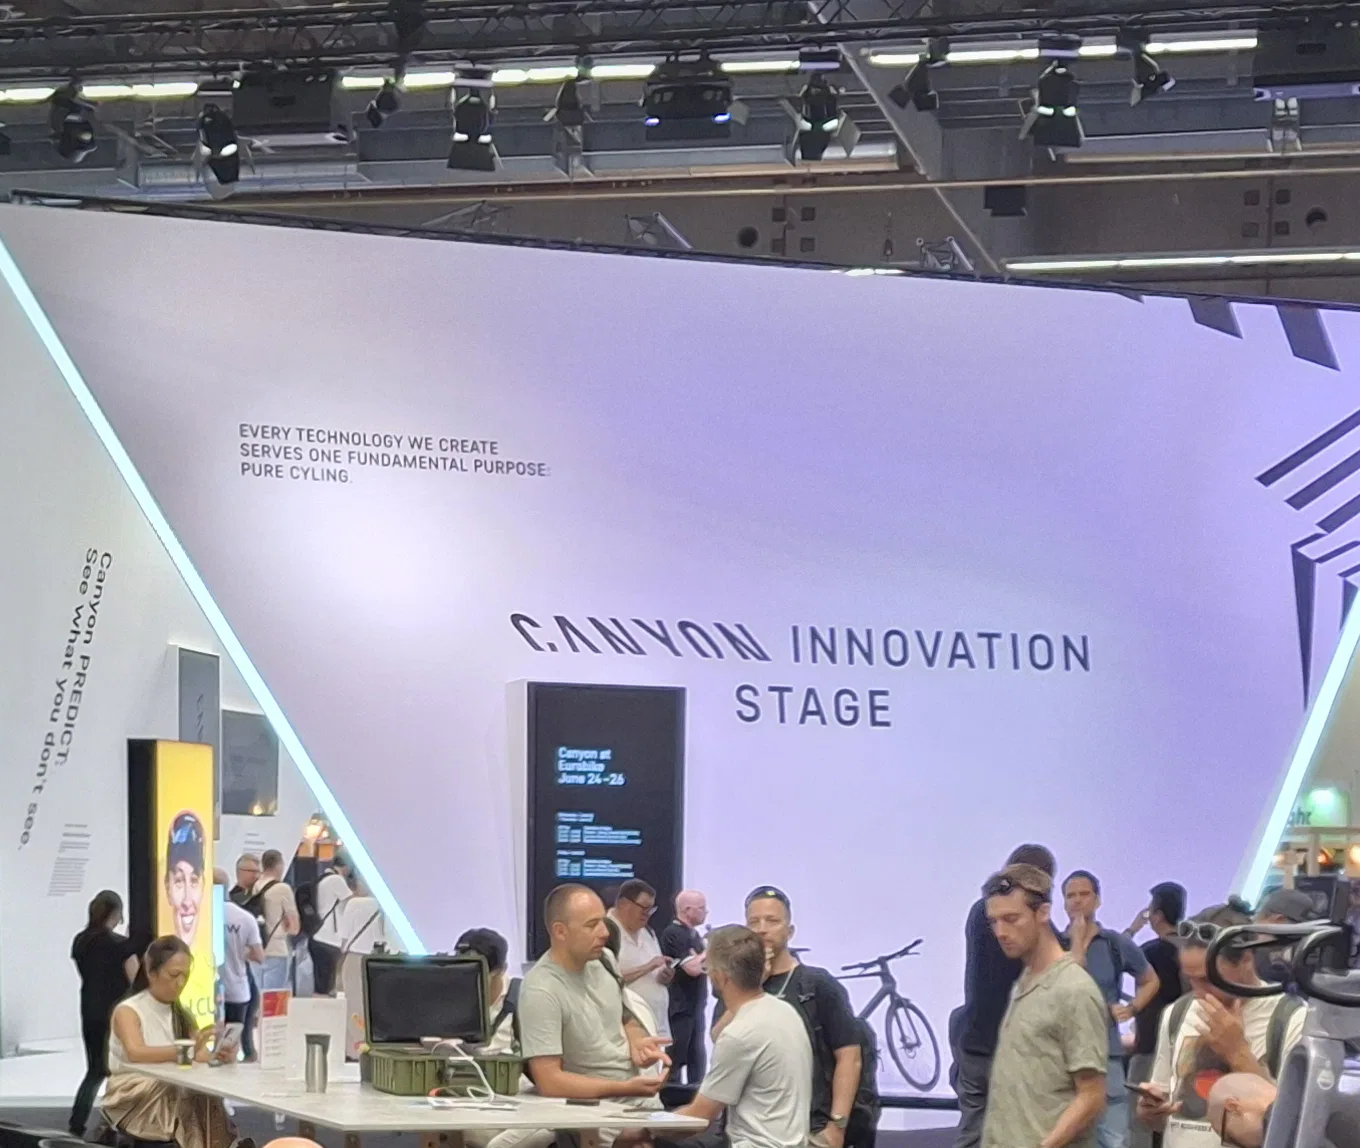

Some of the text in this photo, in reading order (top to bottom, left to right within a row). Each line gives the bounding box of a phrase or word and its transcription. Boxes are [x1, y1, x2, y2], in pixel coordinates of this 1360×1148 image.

[239, 423, 499, 455] EVERY TECHNOLOGY WE CREATE
[240, 443, 303, 461] SERVES
[309, 447, 342, 464] ONE
[347, 450, 468, 473] FUNDAMENTAL
[240, 462, 353, 484] PURE CYLING.
[79, 548, 98, 595] See
[83, 552, 112, 645] Canyon
[62, 604, 84, 670] what
[509, 612, 1092, 673] CANYON INNOVATION
[50, 678, 68, 723] you
[735, 683, 893, 728] STAGE
[32, 732, 56, 794] don't
[558, 747, 597, 760] Canyon
[558, 760, 605, 772] Eurobike
[558, 773, 586, 784] June
